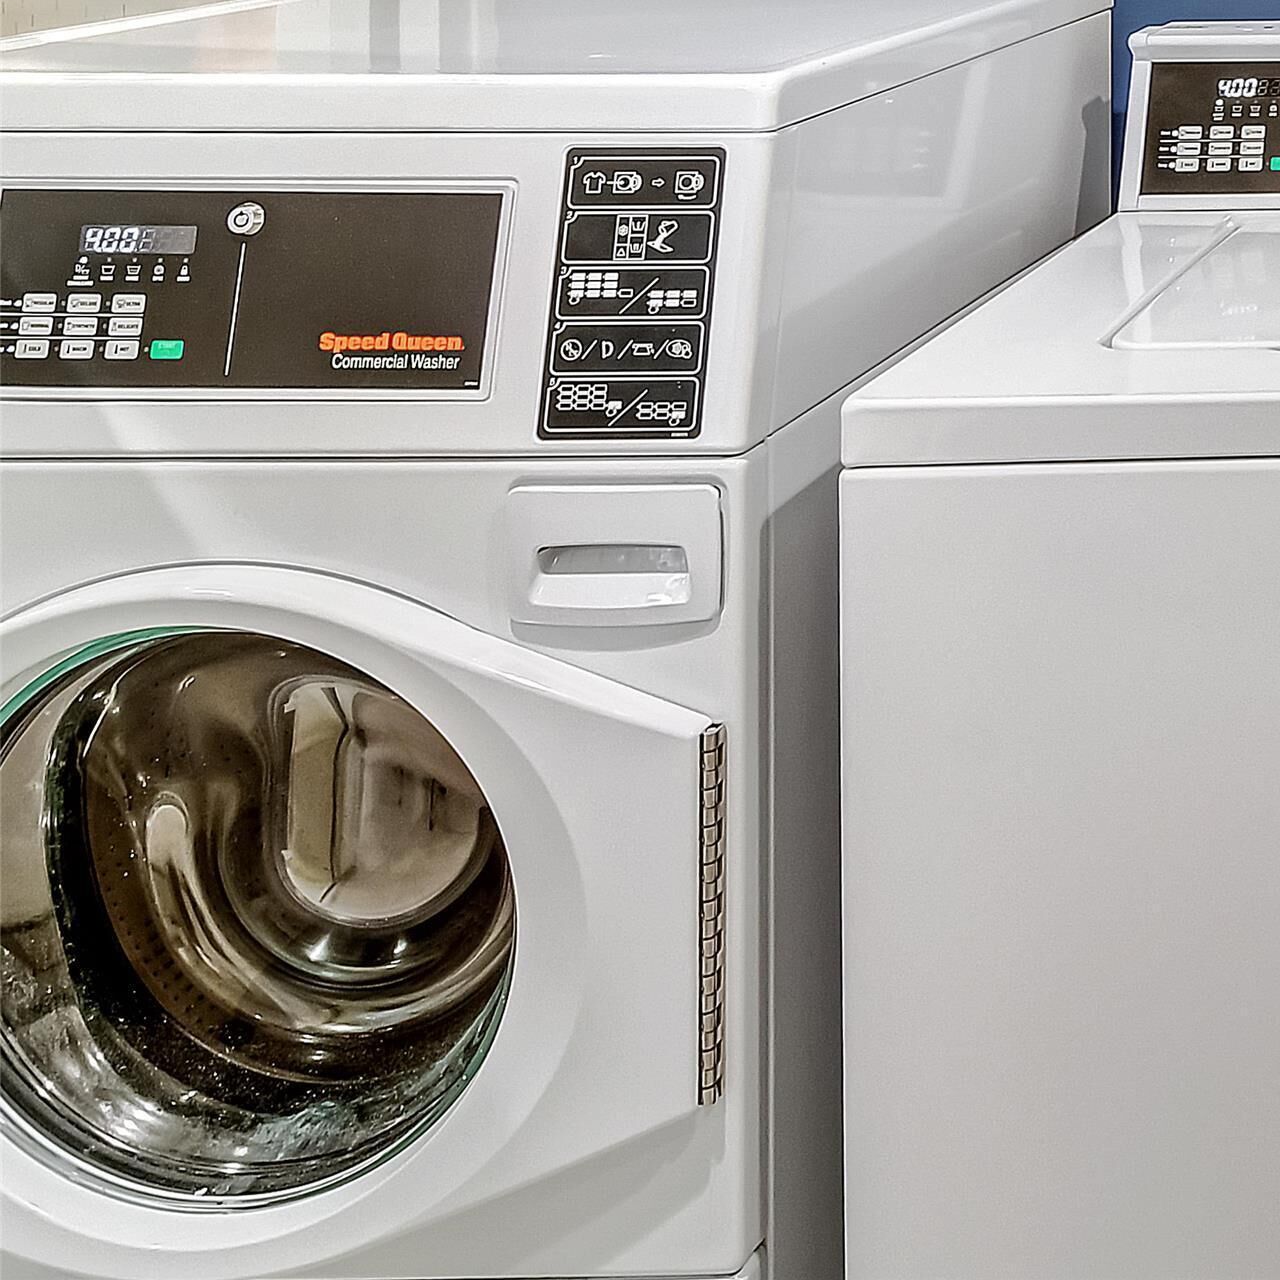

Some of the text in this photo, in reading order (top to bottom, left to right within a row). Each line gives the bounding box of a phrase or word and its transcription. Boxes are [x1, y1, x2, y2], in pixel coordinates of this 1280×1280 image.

[319, 332, 391, 353] Speed
[332, 353, 461, 370] Commercial Washer
